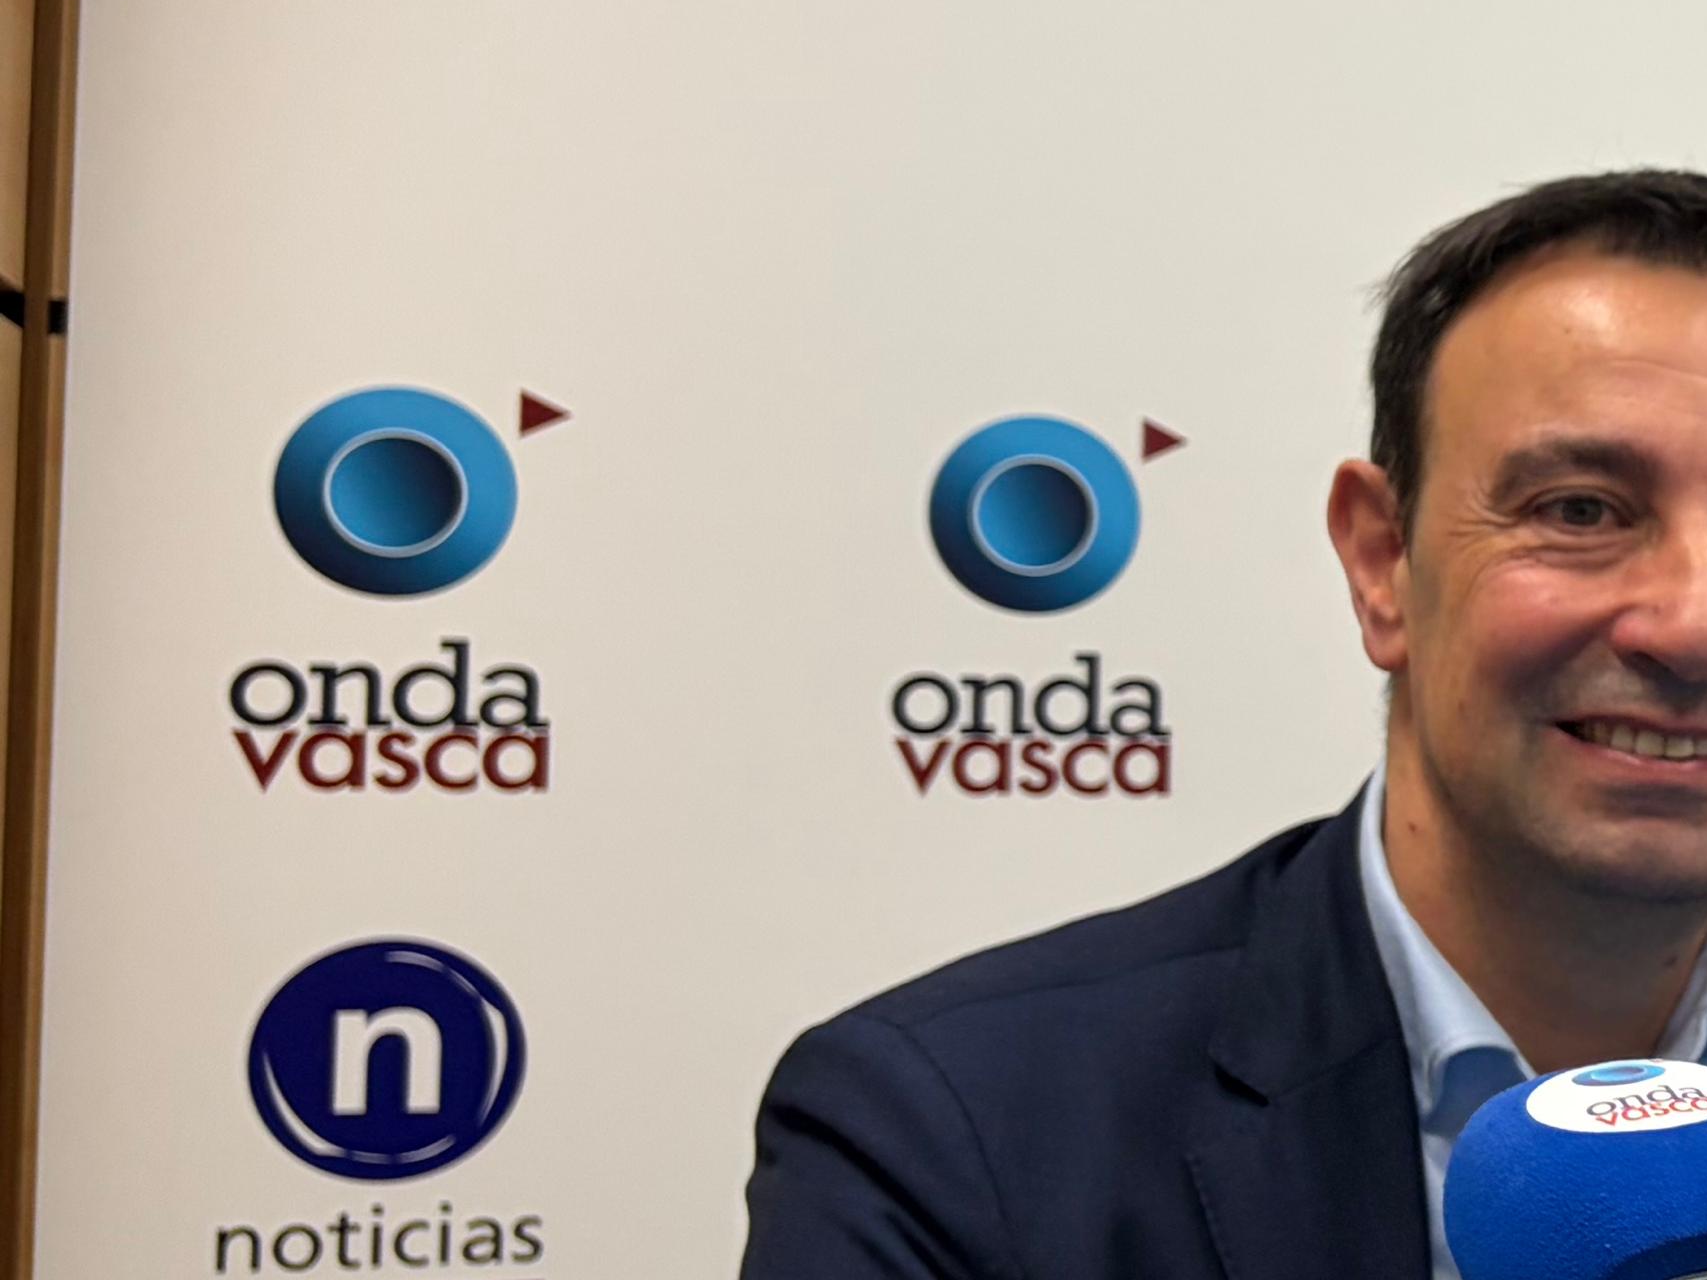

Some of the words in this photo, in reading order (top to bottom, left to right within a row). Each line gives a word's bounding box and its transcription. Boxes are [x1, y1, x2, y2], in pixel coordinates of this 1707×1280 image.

[230, 638, 550, 728] onda
[892, 651, 1172, 738] onda
[231, 727, 550, 793] vasca
[895, 735, 1172, 797] vasca
[332, 1006, 442, 1116] n
[1586, 1085, 1706, 1116] onda
[213, 1203, 545, 1273] noticias
